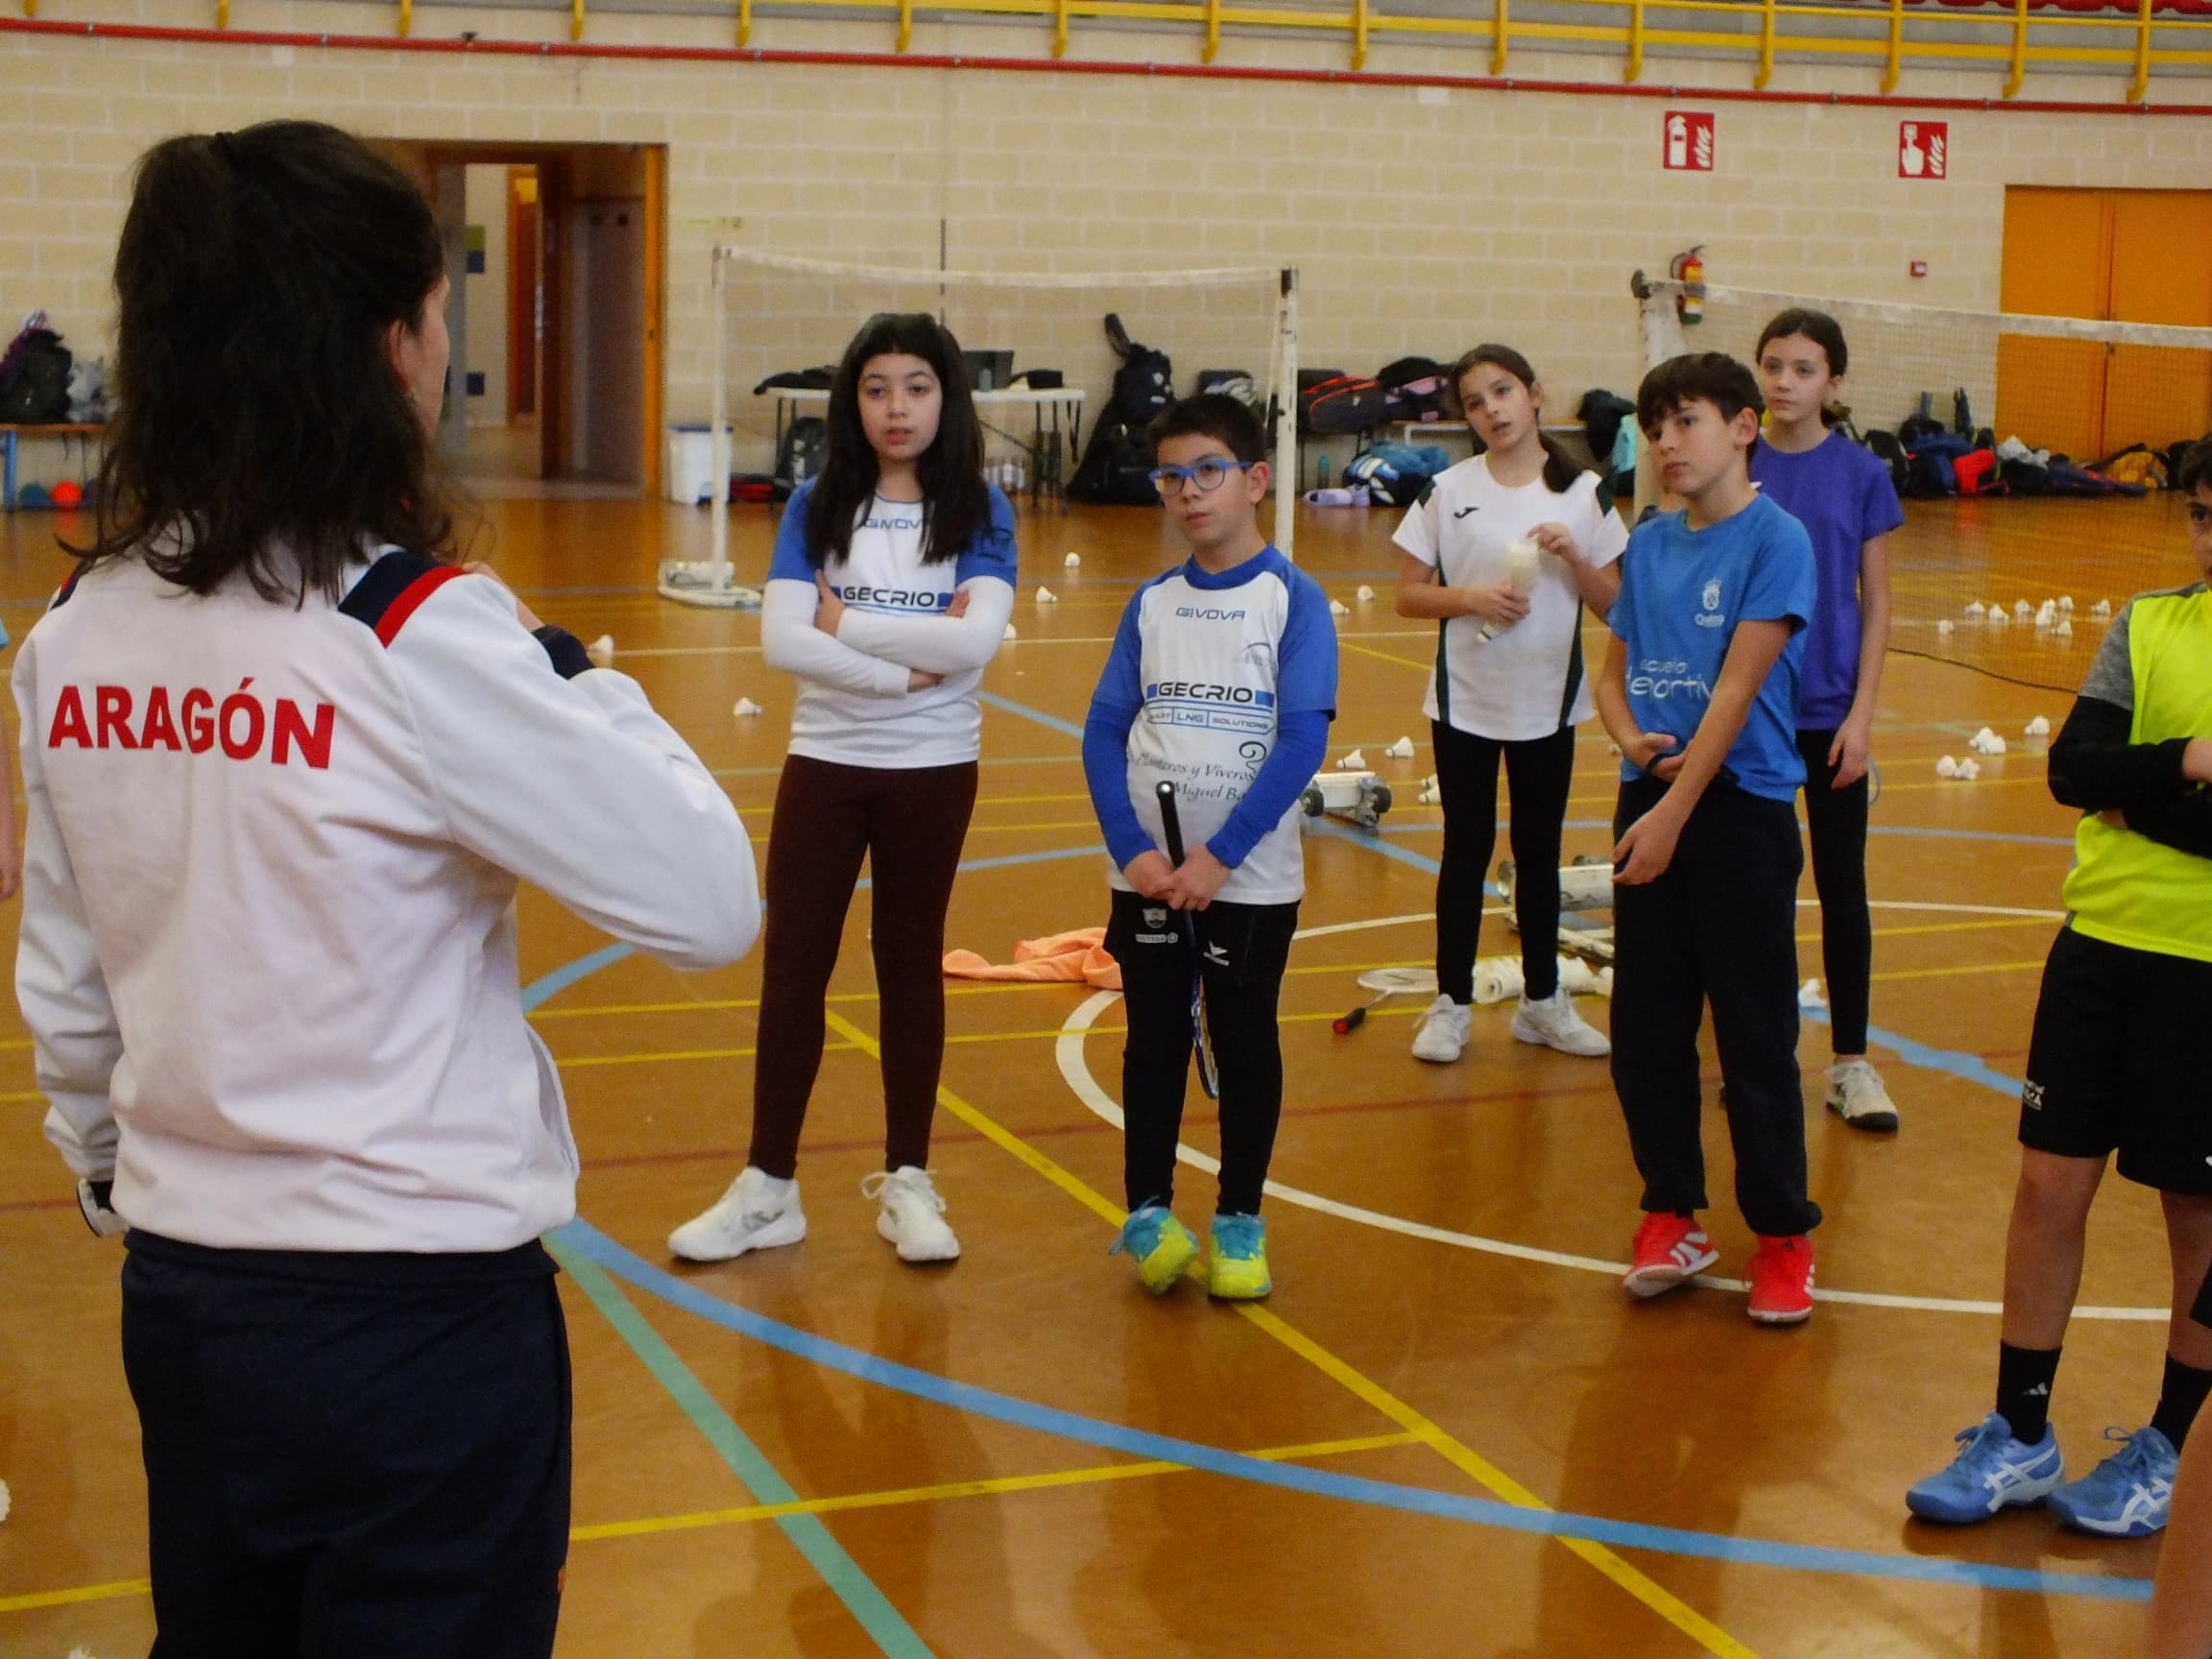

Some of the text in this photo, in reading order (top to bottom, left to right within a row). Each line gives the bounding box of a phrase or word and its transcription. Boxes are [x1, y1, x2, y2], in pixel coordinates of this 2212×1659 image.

[844, 587, 935, 607] GECRIO
[1175, 607, 1245, 620] GIVOVA
[1158, 682, 1253, 703] GECRIO
[48, 677, 335, 770] ARAGÓN
[1176, 712, 1205, 723] LNG
[1212, 717, 1269, 730] SOLUTIONS
